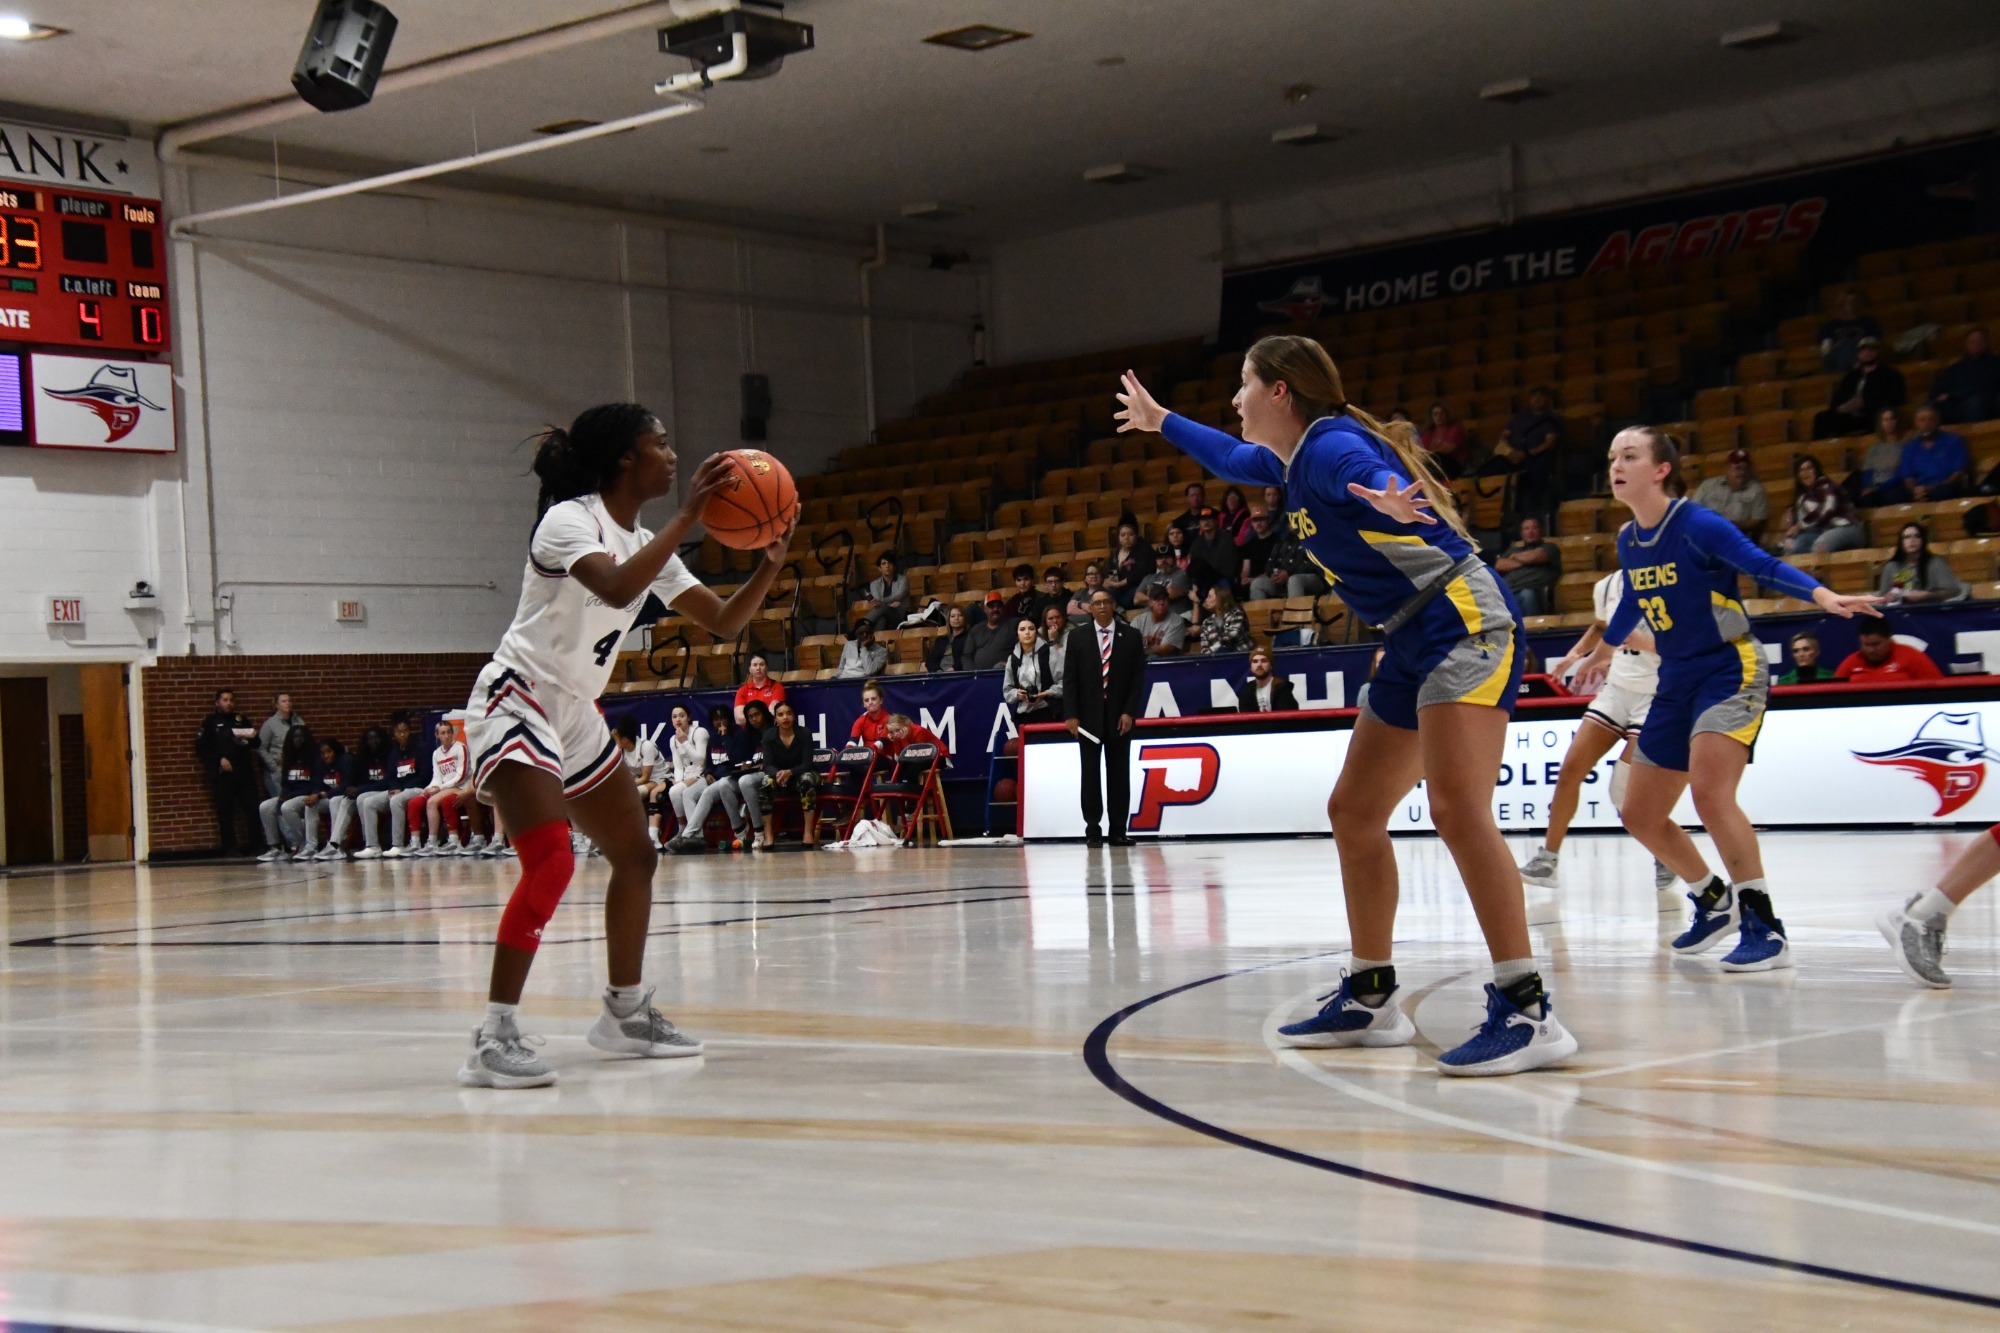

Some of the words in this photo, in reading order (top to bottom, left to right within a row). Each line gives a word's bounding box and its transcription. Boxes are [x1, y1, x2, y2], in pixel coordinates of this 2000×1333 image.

[61, 197, 105, 216] player
[123, 204, 155, 224] fouls
[1344, 270, 1439, 312] HOME
[1449, 258, 1494, 292] OF
[1504, 246, 1577, 282] THE
[1581, 196, 1828, 278] AGGIES
[129, 282, 161, 299] team
[79, 302, 101, 337] 4
[141, 307, 162, 343] 0
[52, 599, 81, 622] EXIT
[342, 602, 359, 618] EXIT
[593, 629, 622, 667] 4
